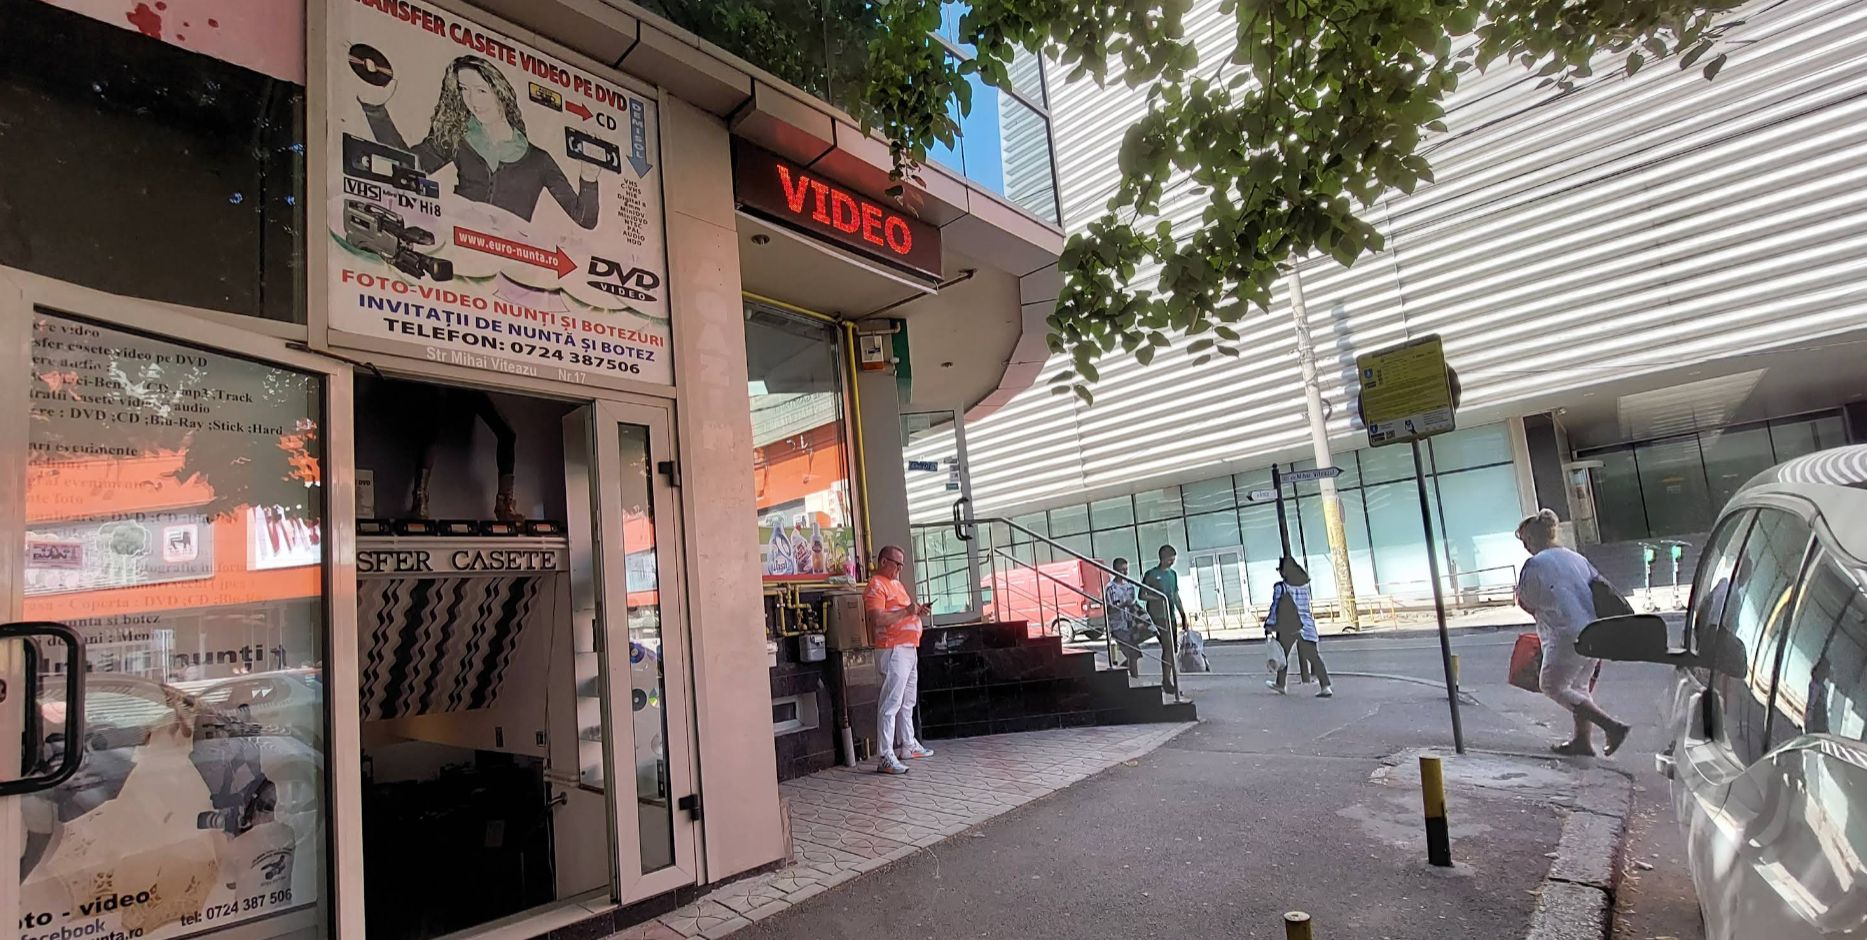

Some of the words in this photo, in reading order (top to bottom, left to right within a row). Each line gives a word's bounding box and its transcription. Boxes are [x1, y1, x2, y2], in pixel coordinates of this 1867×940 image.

[449, 22, 517, 67] CASETE
[519, 50, 571, 88] VIDEO
[573, 73, 593, 99] PE
[595, 83, 628, 112] DVD
[596, 112, 617, 131] CD
[631, 103, 644, 159] DEMISOL
[345, 179, 380, 200] VHS
[623, 178, 638, 188] VHS
[420, 201, 441, 217] Hi8
[776, 163, 913, 255] VIDEO
[624, 219, 642, 230] NTSC
[627, 225, 641, 235] PAL
[622, 230, 646, 242] AUDIO
[458, 232, 559, 266] www.euro-nunta.ro
[587, 255, 661, 290] DVD
[600, 282, 647, 301] VIDEO
[341, 268, 488, 310] FOTO-VIDEO
[581, 319, 664, 348] BOTEZURI
[383, 317, 505, 351] TELEFON:
[510, 341, 565, 361] 0724
[569, 351, 641, 375] 387506
[475, 316, 503, 333] DE
[508, 323, 576, 347] NUNTĂ
[601, 342, 656, 362] BOTEZ
[156, 353, 172, 366] pe
[175, 354, 208, 368] DVD
[426, 346, 448, 362] Str
[450, 349, 487, 369] Mihai
[490, 357, 538, 377] Viteazu
[70, 407, 106, 420] DVD
[174, 402, 210, 414] audio
[356, 550, 433, 573] SFER
[452, 550, 557, 571] CASETE
[122, 614, 161, 626] botez
[79, 890, 151, 916] video
[180, 910, 203, 927] tel:
[206, 900, 240, 921] 0724
[243, 893, 267, 912] 387
[269, 887, 293, 905] 506
